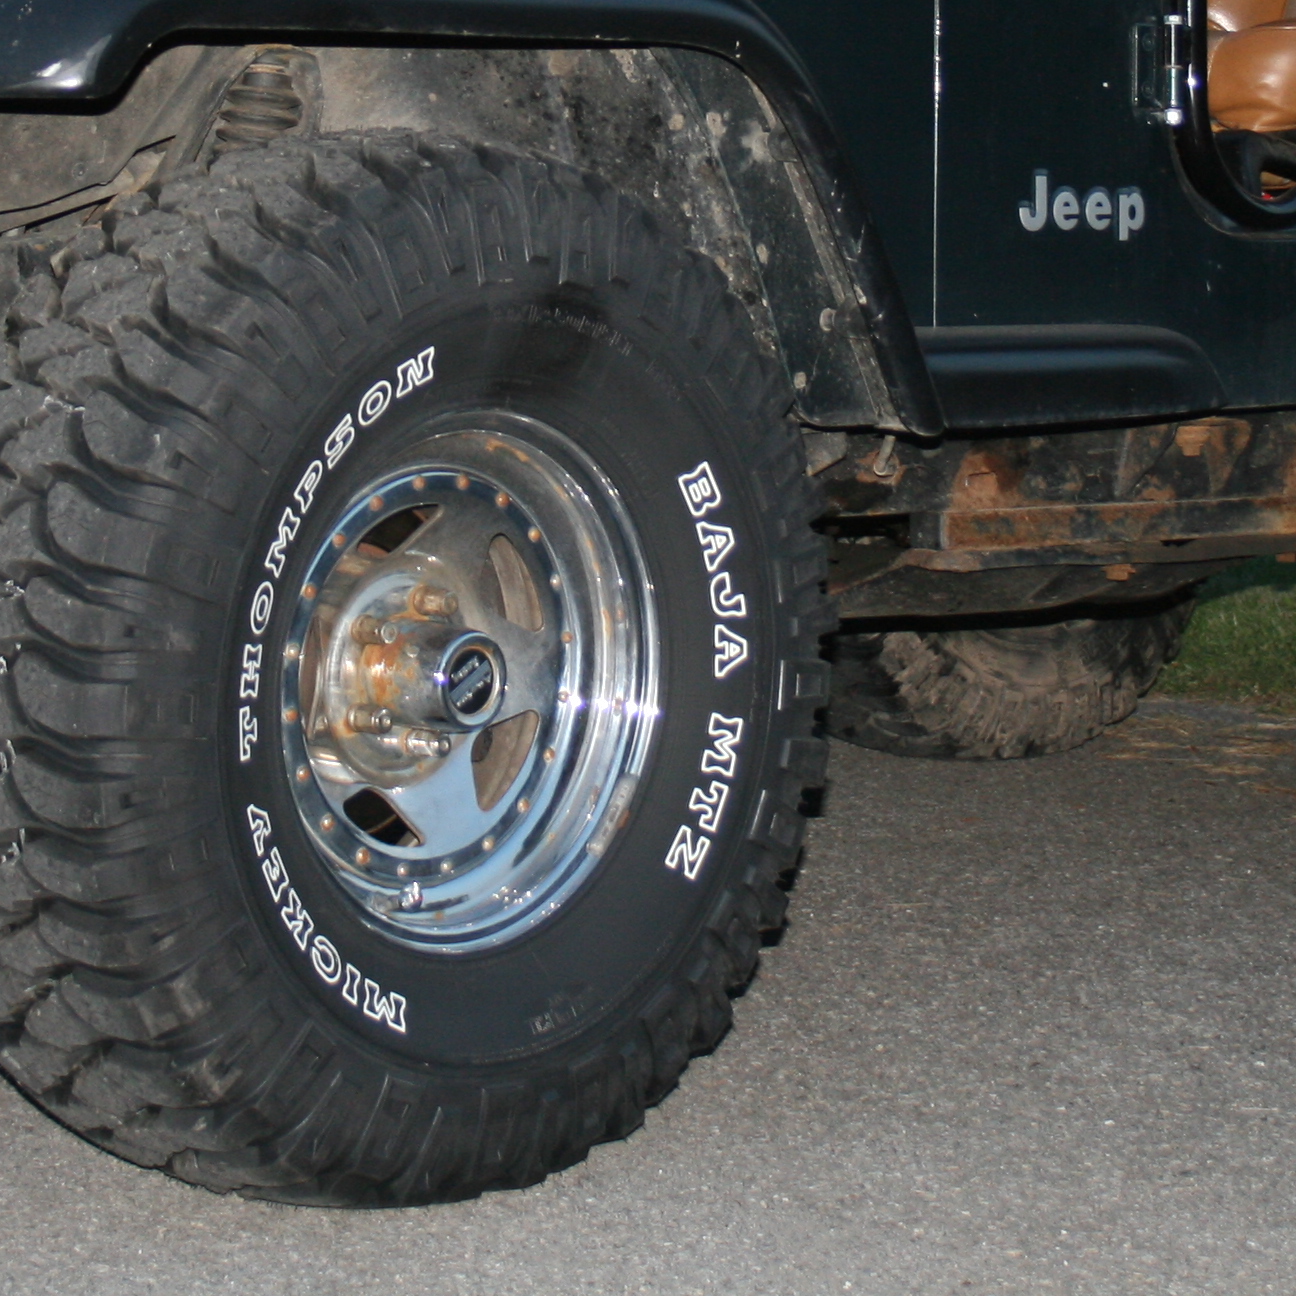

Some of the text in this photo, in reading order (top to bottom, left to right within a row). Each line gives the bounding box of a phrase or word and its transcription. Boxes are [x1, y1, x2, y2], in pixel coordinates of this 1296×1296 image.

[1018, 169, 1146, 240] Jeep
[239, 346, 436, 1034] MICKEY THOMPSON
[664, 461, 749, 881] BAJA MTZ
